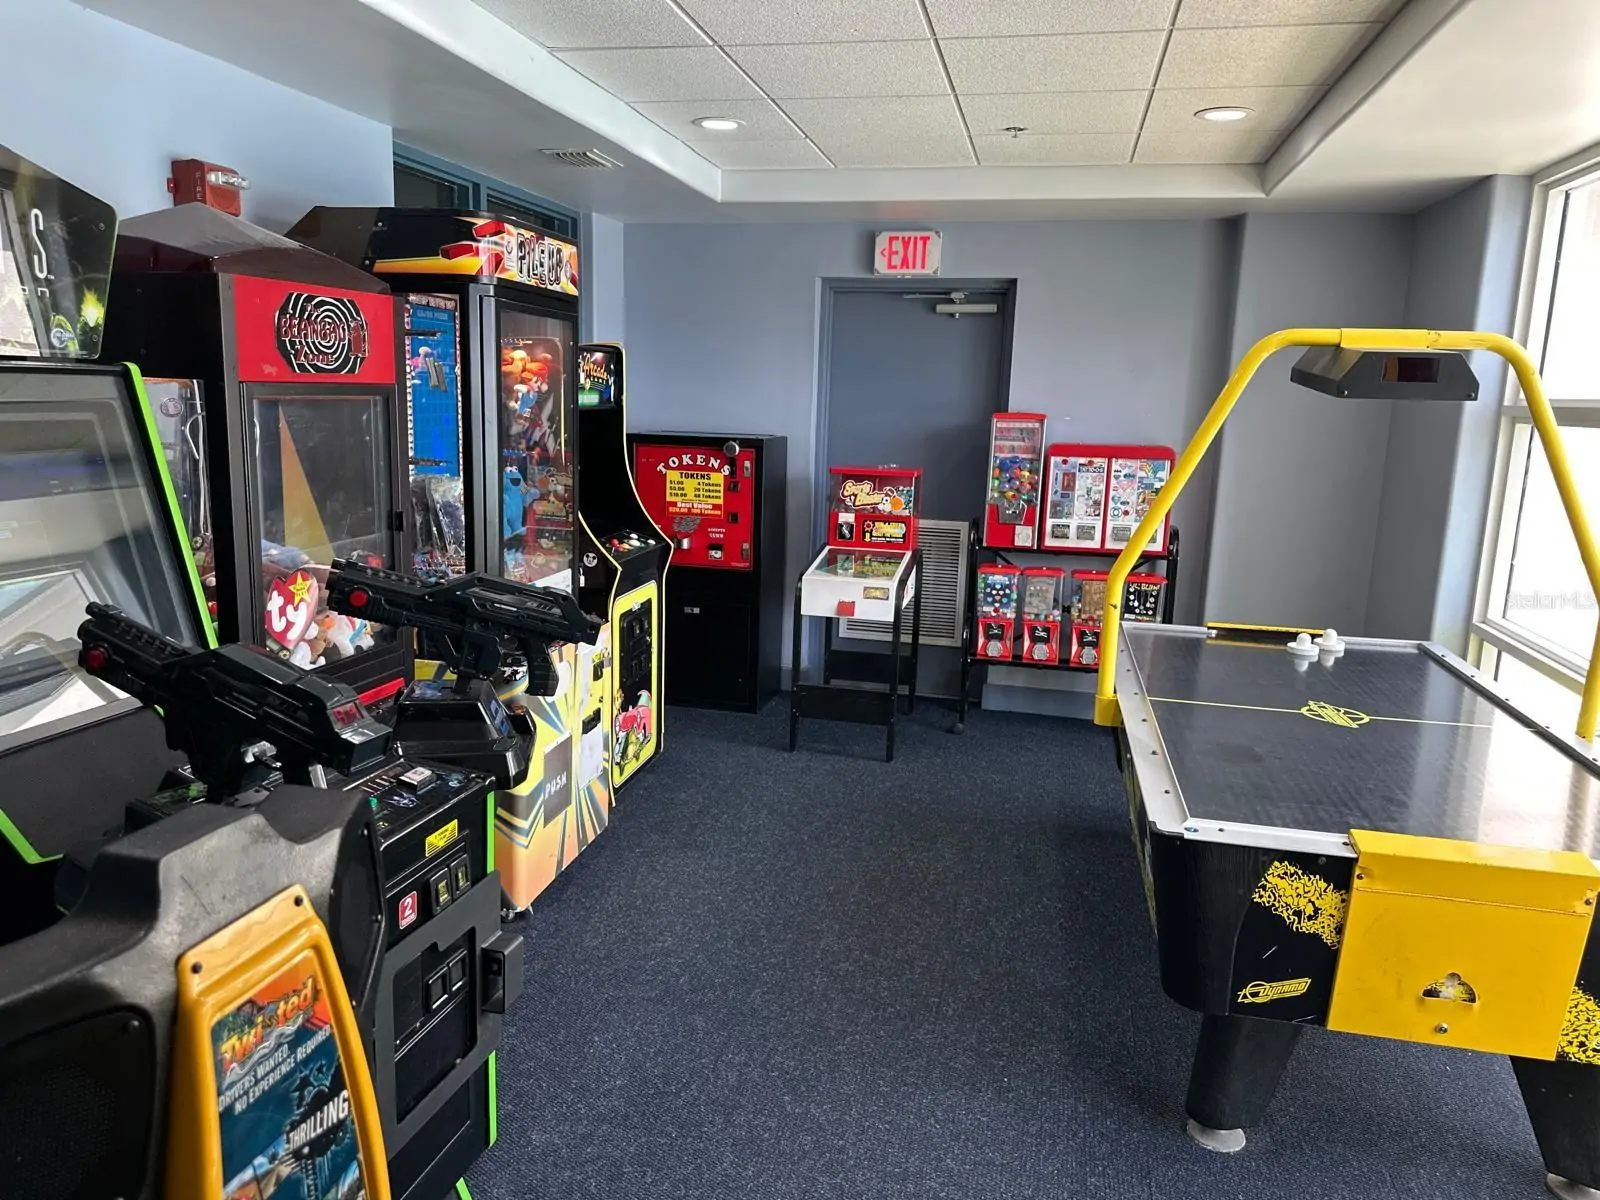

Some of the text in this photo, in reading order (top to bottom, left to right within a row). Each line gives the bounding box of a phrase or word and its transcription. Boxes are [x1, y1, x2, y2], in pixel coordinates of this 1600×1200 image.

[887, 235, 931, 270] EXIT
[656, 453, 731, 476] TOKENS
[679, 472, 711, 480] TOKENS
[266, 590, 308, 640] ty
[544, 771, 567, 800] PUSH
[403, 897, 413, 917] 2
[218, 1072, 256, 1112] DRIVERS
[234, 1097, 248, 1115] NO
[249, 1058, 296, 1106] EXPERIENCE
[287, 1089, 350, 1151] THRILLING
